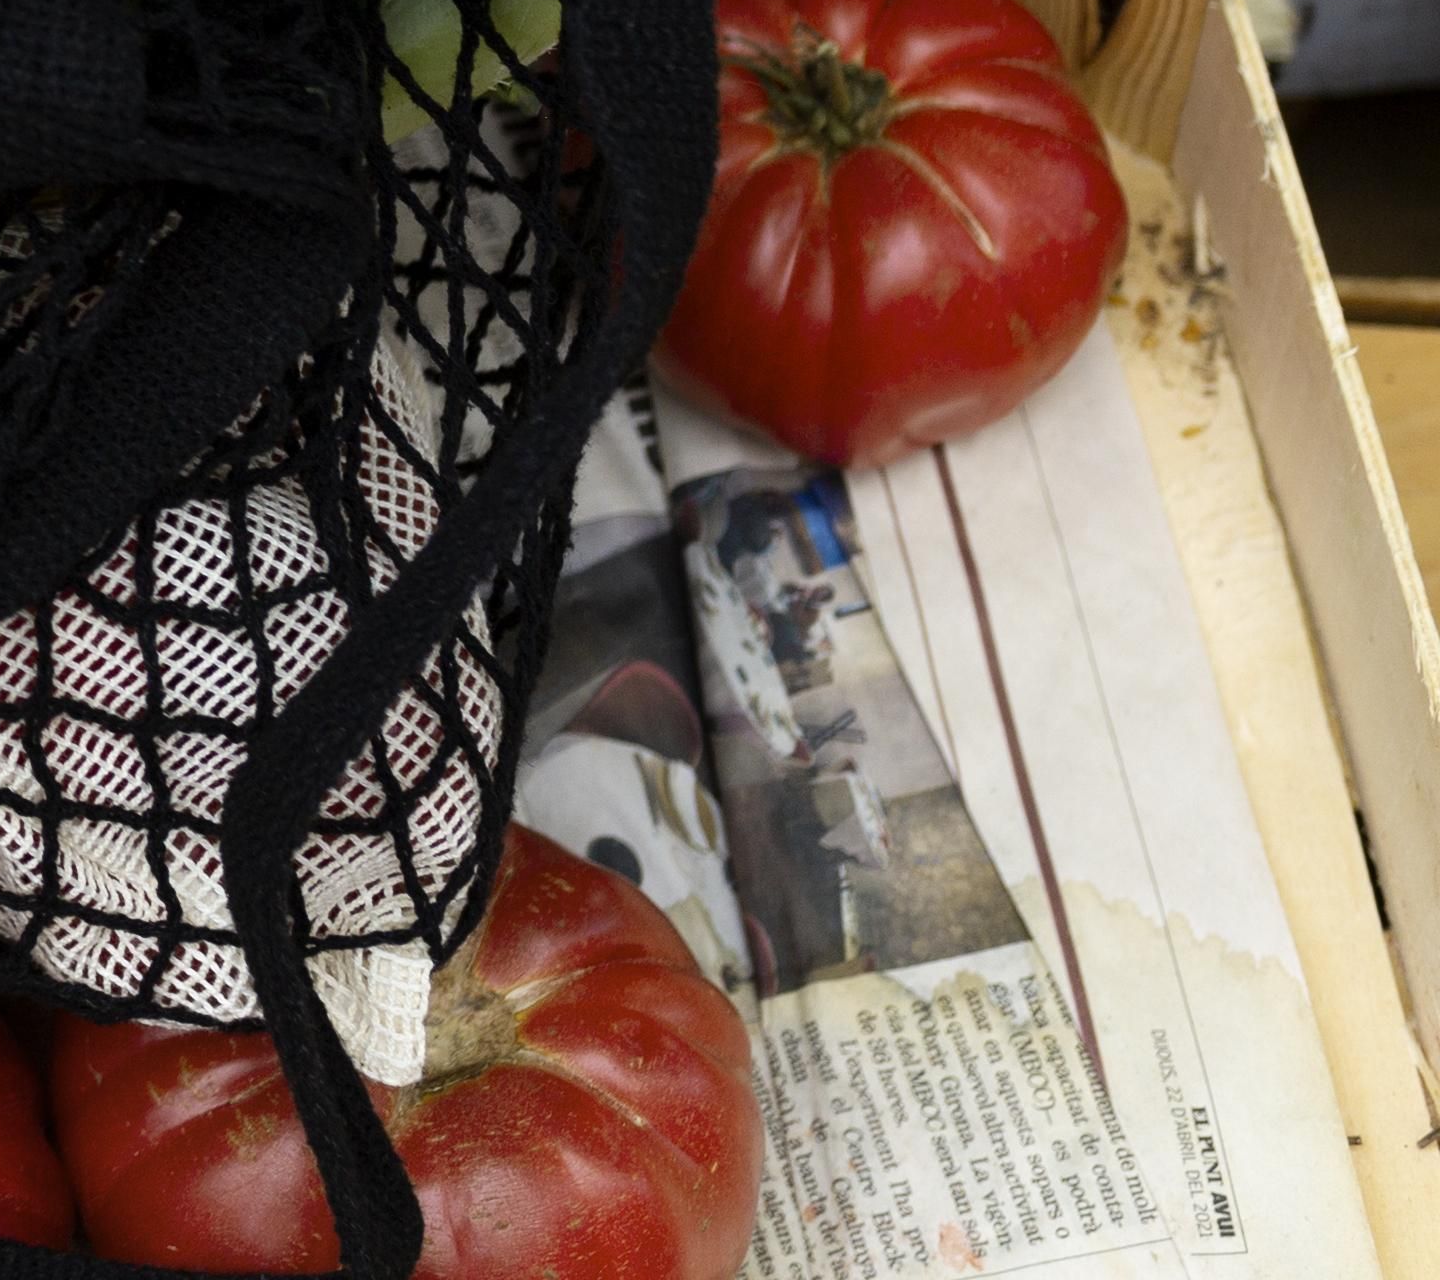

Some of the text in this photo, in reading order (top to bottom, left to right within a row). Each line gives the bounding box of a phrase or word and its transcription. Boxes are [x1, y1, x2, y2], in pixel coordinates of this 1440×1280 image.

[881, 1001, 908, 1035] cia
[893, 1032, 922, 1069] del
[854, 1005, 881, 1036] de
[876, 1064, 913, 1129] hores.
[1035, 1030, 1093, 1129] capacitat
[787, 1135, 805, 1150] a
[935, 991, 1047, 1247] en qualsevol altra activitat
[936, 1072, 982, 1150] Girona.
[962, 986, 1072, 1241] anar en aquests sopars o
[1077, 1128, 1105, 1158] de
[1151, 1026, 1214, 1239] DIJOUS, 22 D'ABRIL DEL 2021
[777, 1025, 882, 1280] chain de Catalunya
[800, 1017, 910, 1276] mogut el Centre Block-
[835, 1035, 936, 1271] L'experiment l'ha pro-
[929, 1131, 962, 1179] serà
[968, 1154, 994, 1184] La
[1050, 1137, 1071, 1163] es
[1113, 1144, 1138, 1173] de
[1189, 1104, 1236, 1240] EL PUNT AVUI
[792, 1150, 834, 1223] banda
[947, 1178, 974, 1216] tan
[1059, 1170, 1104, 1237] podrà
[1089, 1159, 1130, 1230] conta-
[1124, 1171, 1161, 1226] molt
[760, 1187, 798, 1258] alguns
[816, 1216, 843, 1247] de
[960, 1215, 993, 1260] sols
[977, 1188, 1020, 1256] vigèn-
